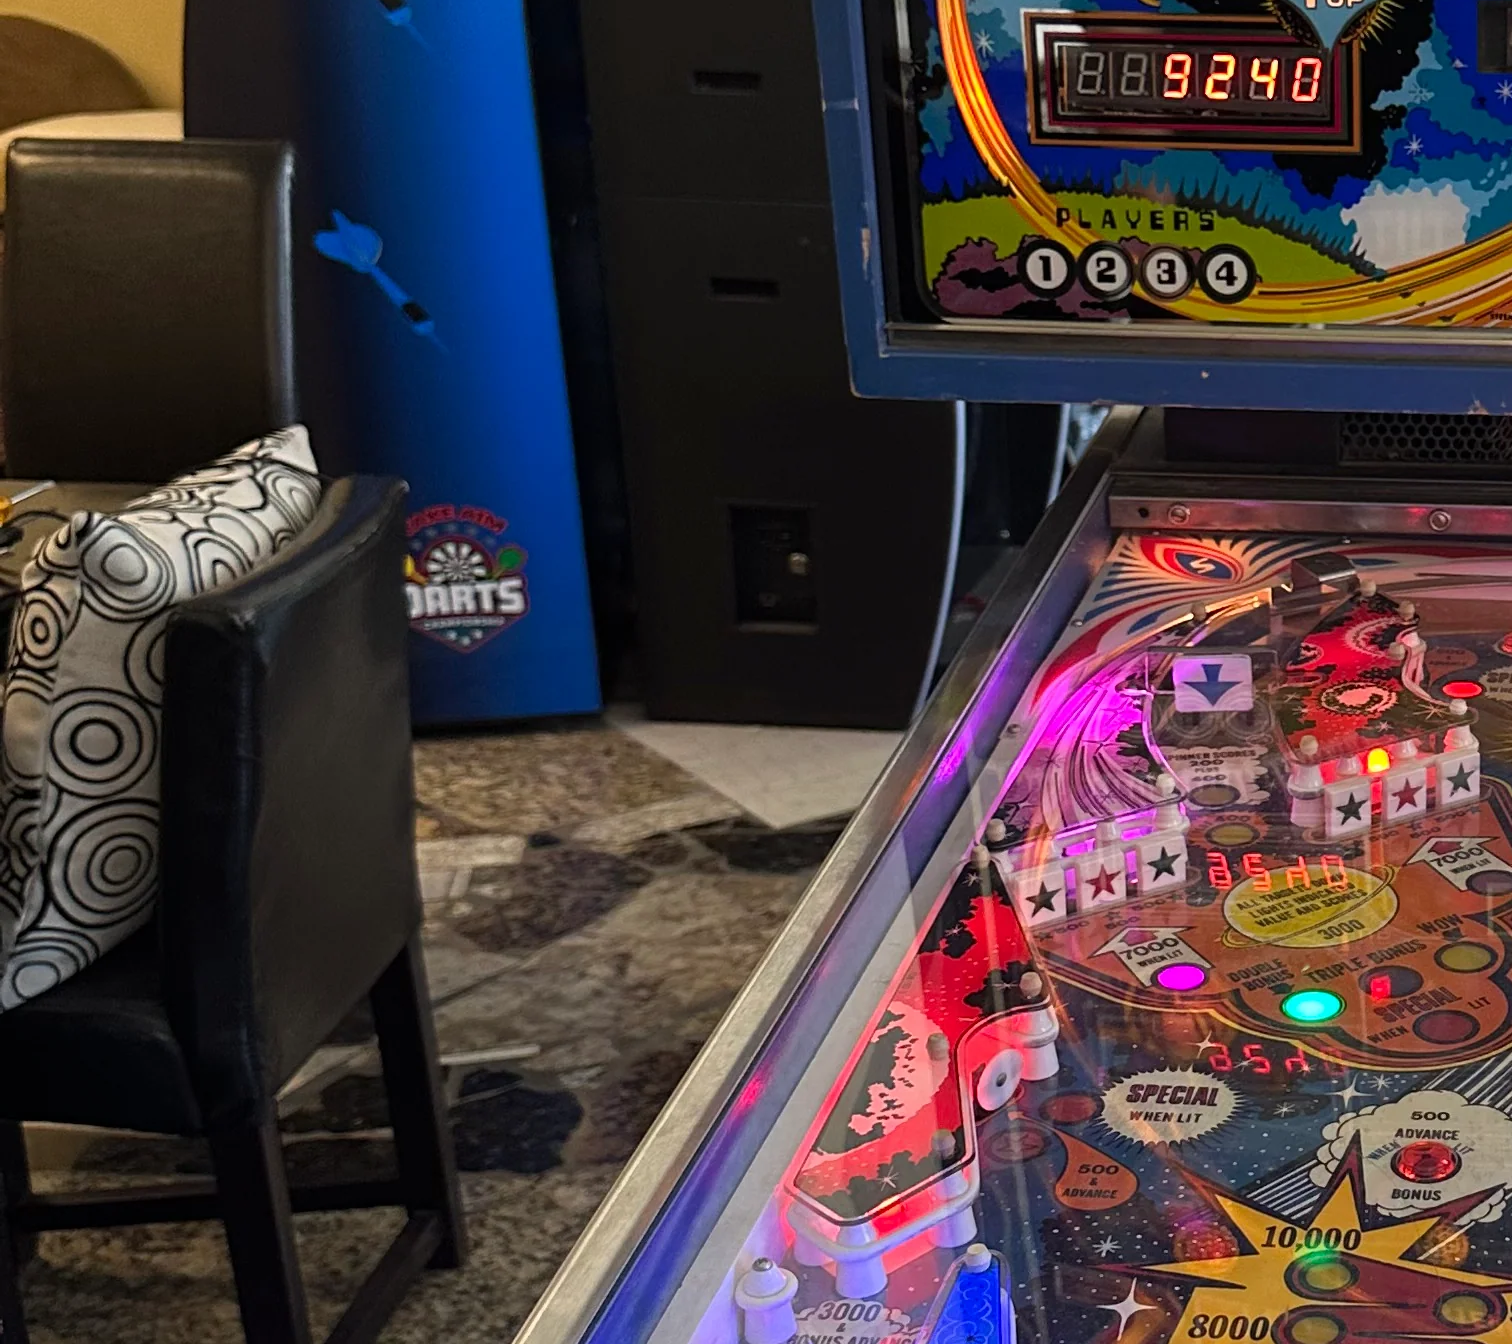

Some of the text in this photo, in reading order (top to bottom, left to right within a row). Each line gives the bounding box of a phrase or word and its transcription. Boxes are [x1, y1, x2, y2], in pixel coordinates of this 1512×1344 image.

[1162, 54, 1322, 102] 9240
[1056, 208, 1215, 231] PLAYERS
[1039, 255, 1238, 286] 1 2 3 4
[1429, 847, 1485, 867] 7000
[1248, 899, 1295, 919] LIGHTS
[1255, 888, 1369, 928] VALUE AND SCORES
[1317, 919, 1365, 940] 3000
[1415, 913, 1464, 935] WOW
[1119, 937, 1180, 961] 7000
[1226, 958, 1288, 984] DOUBLE
[1303, 939, 1428, 984] TRIPLE BONUS
[1243, 969, 1295, 992] BONUS
[1373, 987, 1463, 1024] SPECIAL
[1367, 996, 1491, 1044] WHEN LIT
[1126, 1084, 1219, 1107] SPECIAL
[1130, 1110, 1203, 1124] WHEN LIT
[1411, 1111, 1450, 1121] 500
[1395, 1128, 1460, 1141] ADVANCE
[1366, 1140, 1402, 1160] WHEN
[1078, 1163, 1119, 1175] 500
[1062, 1187, 1118, 1200] ADVANCE
[1391, 1188, 1442, 1201] BONUS
[1260, 1224, 1362, 1252] 10,000
[817, 1303, 882, 1323] 3000
[1187, 1314, 1270, 1341] 8000
